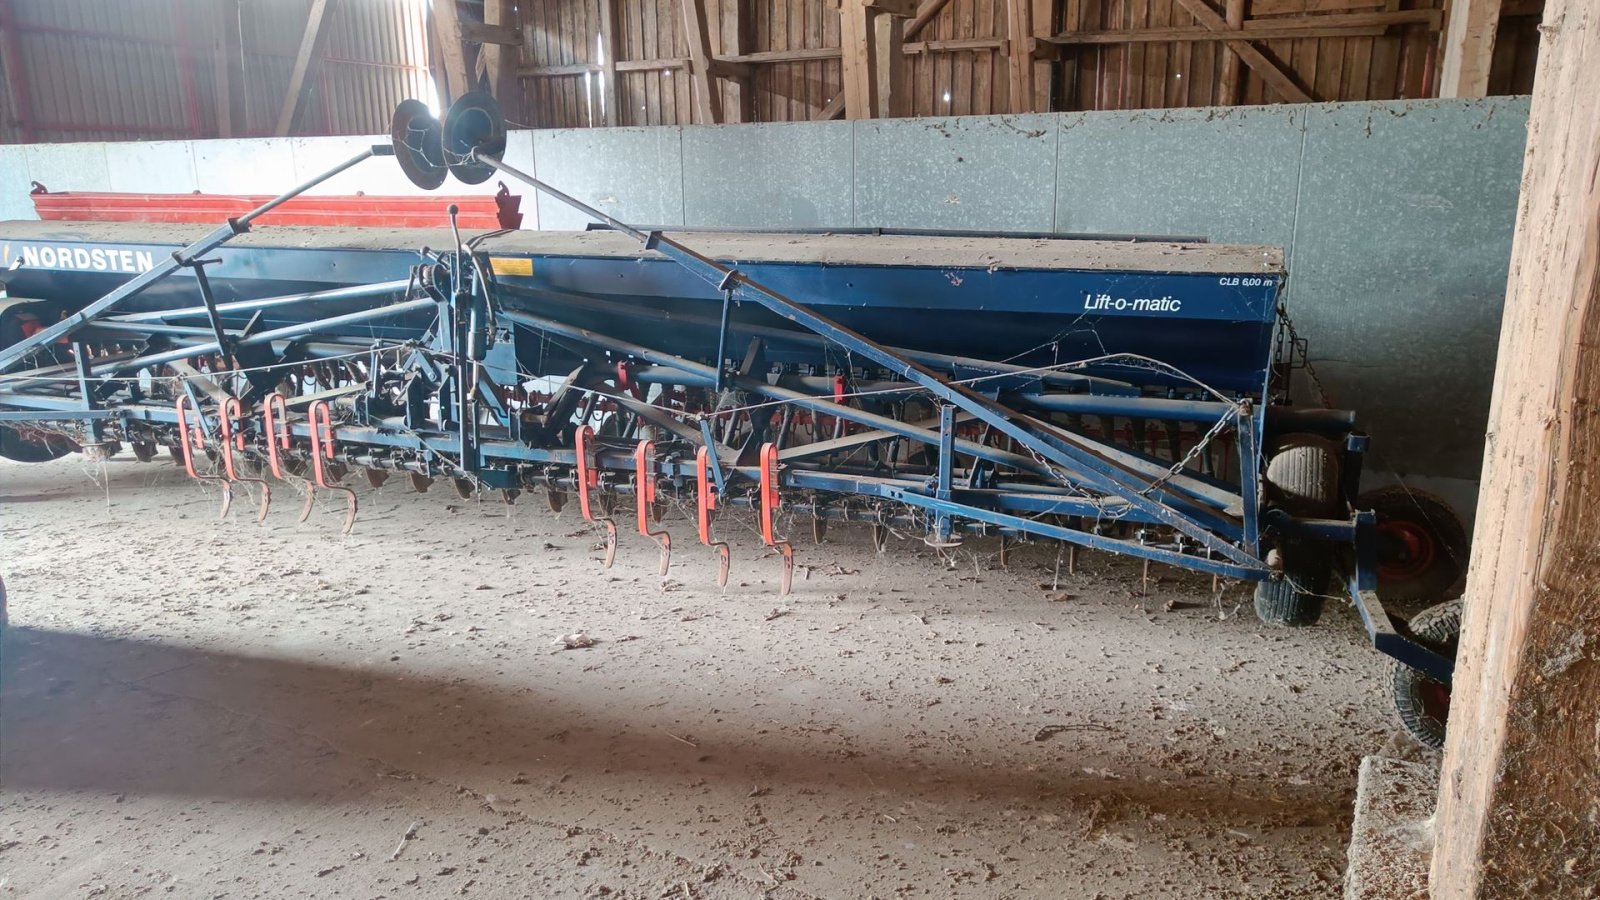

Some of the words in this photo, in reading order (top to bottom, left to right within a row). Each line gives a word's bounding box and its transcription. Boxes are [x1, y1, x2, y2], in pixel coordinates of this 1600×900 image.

[22, 246, 154, 272] NORDSTEN
[1219, 277, 1239, 286] CLB
[1263, 279, 1273, 287] m
[1084, 294, 1181, 312] Lift-o-matic
